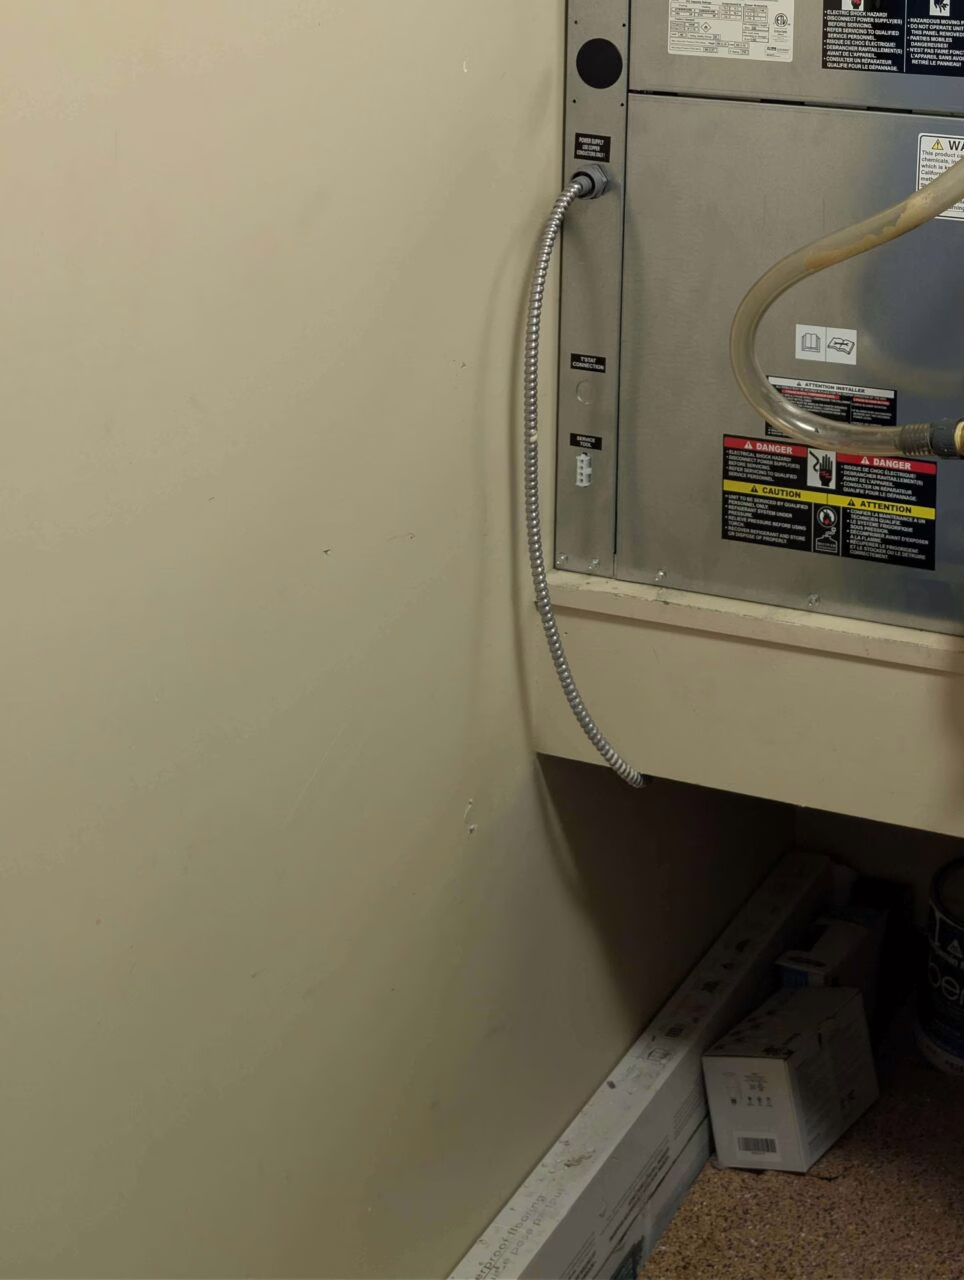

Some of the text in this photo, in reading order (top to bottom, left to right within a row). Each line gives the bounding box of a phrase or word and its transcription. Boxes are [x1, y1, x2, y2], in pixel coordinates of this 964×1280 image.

[572, 362, 604, 370] CONNECTION
[756, 442, 792, 455] DANGER
[873, 458, 911, 470] DANGER
[762, 487, 801, 498] CAUTION
[860, 501, 912, 513] ATTENTION
